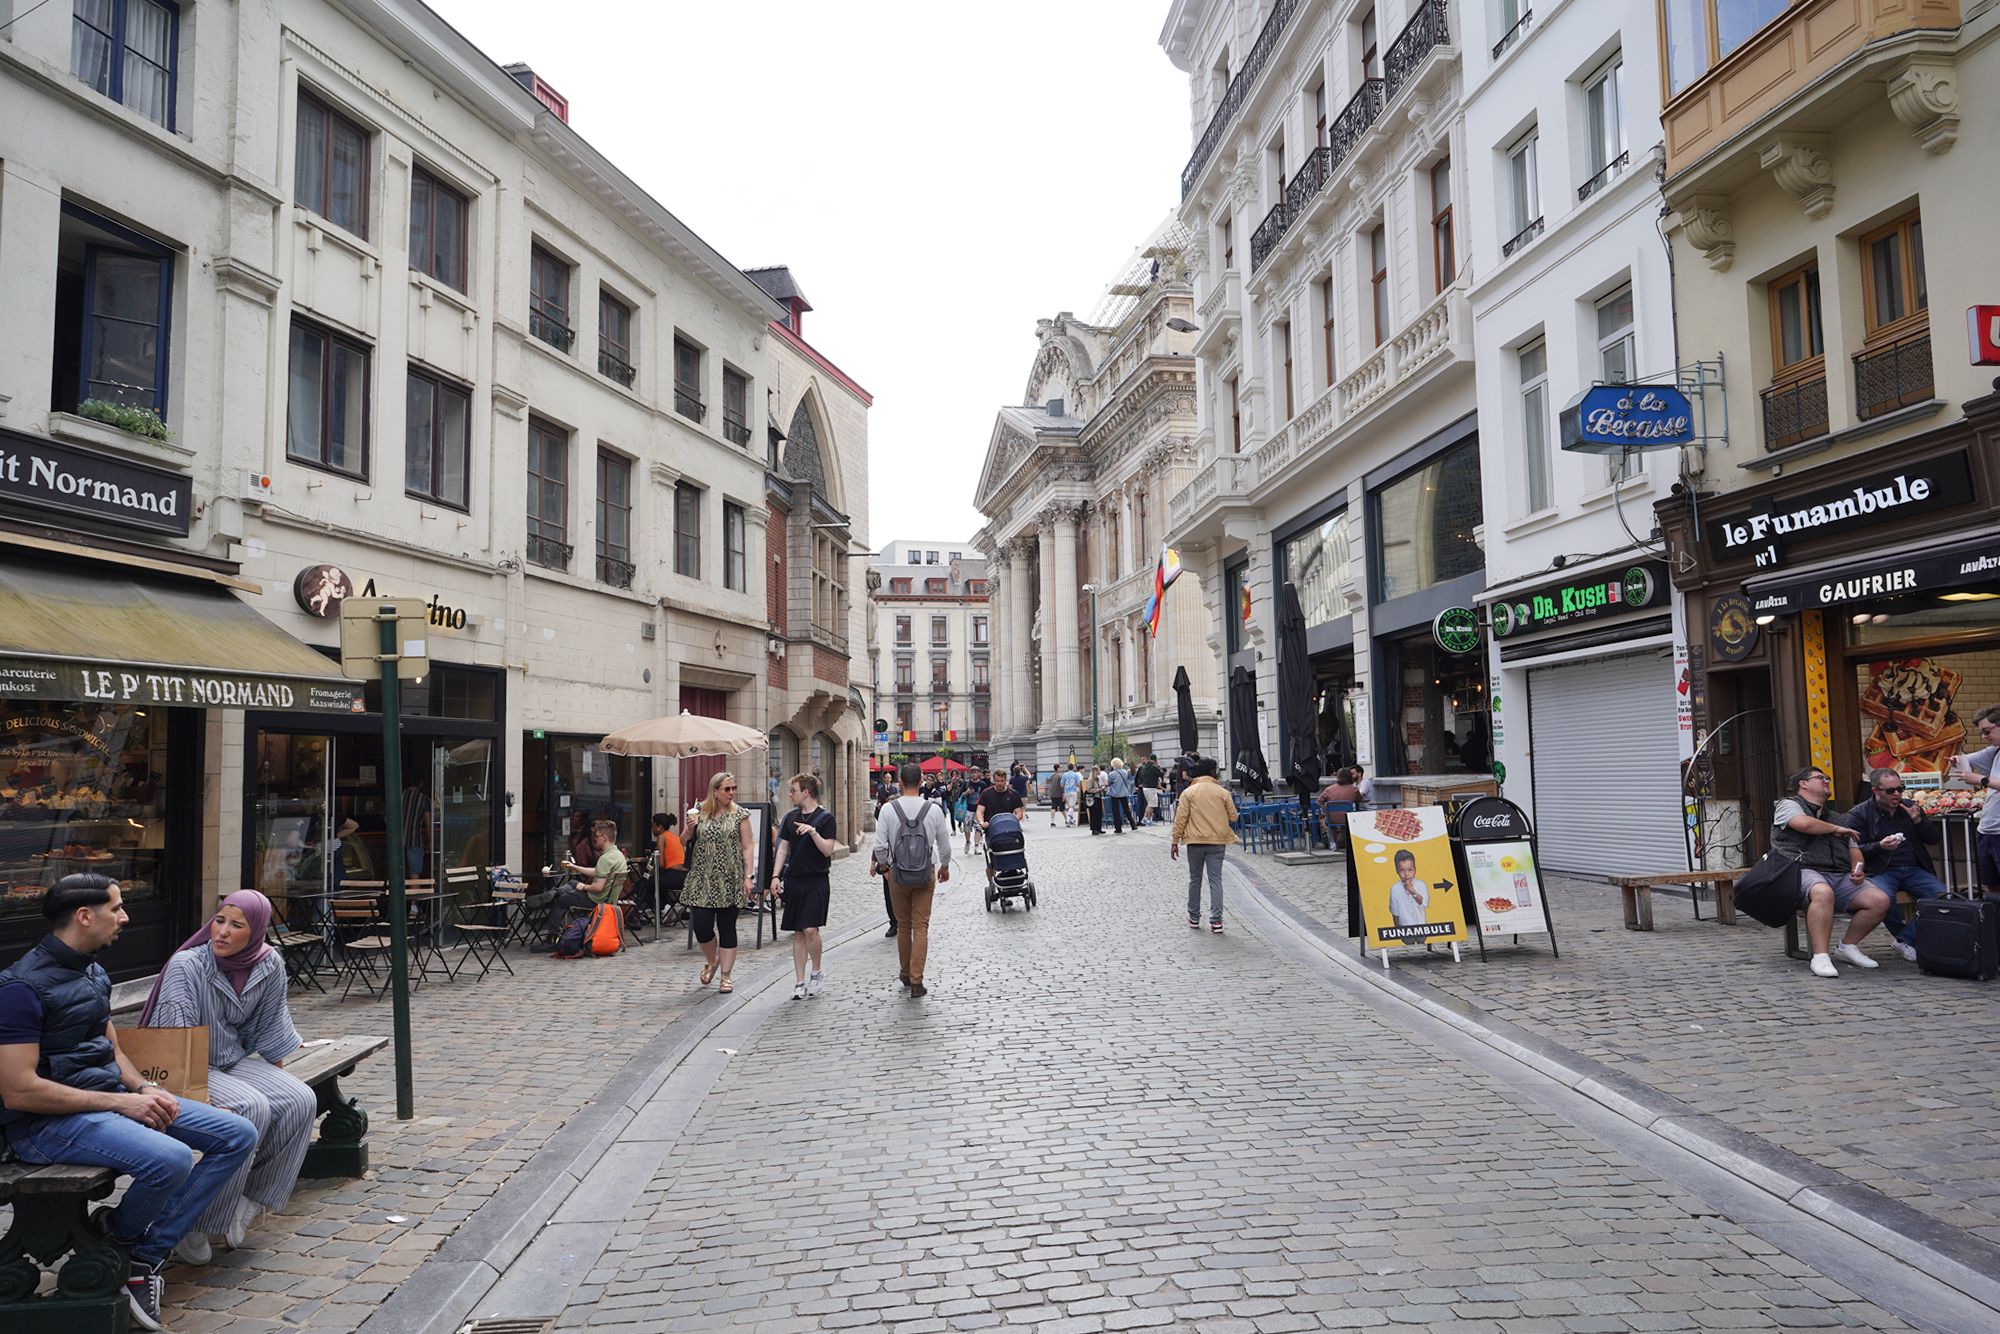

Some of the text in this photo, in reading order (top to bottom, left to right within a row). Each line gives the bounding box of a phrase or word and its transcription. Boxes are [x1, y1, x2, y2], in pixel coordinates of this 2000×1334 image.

[28, 456, 177, 516] Normand
[1820, 569, 1917, 603] GAUFRIER
[1755, 595, 1788, 610] LAVAZZA
[0, 668, 57, 680] arcuterie
[81, 670, 117, 699] LE
[191, 678, 294, 708] NORMAND
[311, 687, 352, 699] Fromagerie
[6, 717, 60, 730] DELICIOUS
[1473, 814, 1511, 829] Coca-Cola
[1382, 924, 1451, 938] FUNAMBULE
